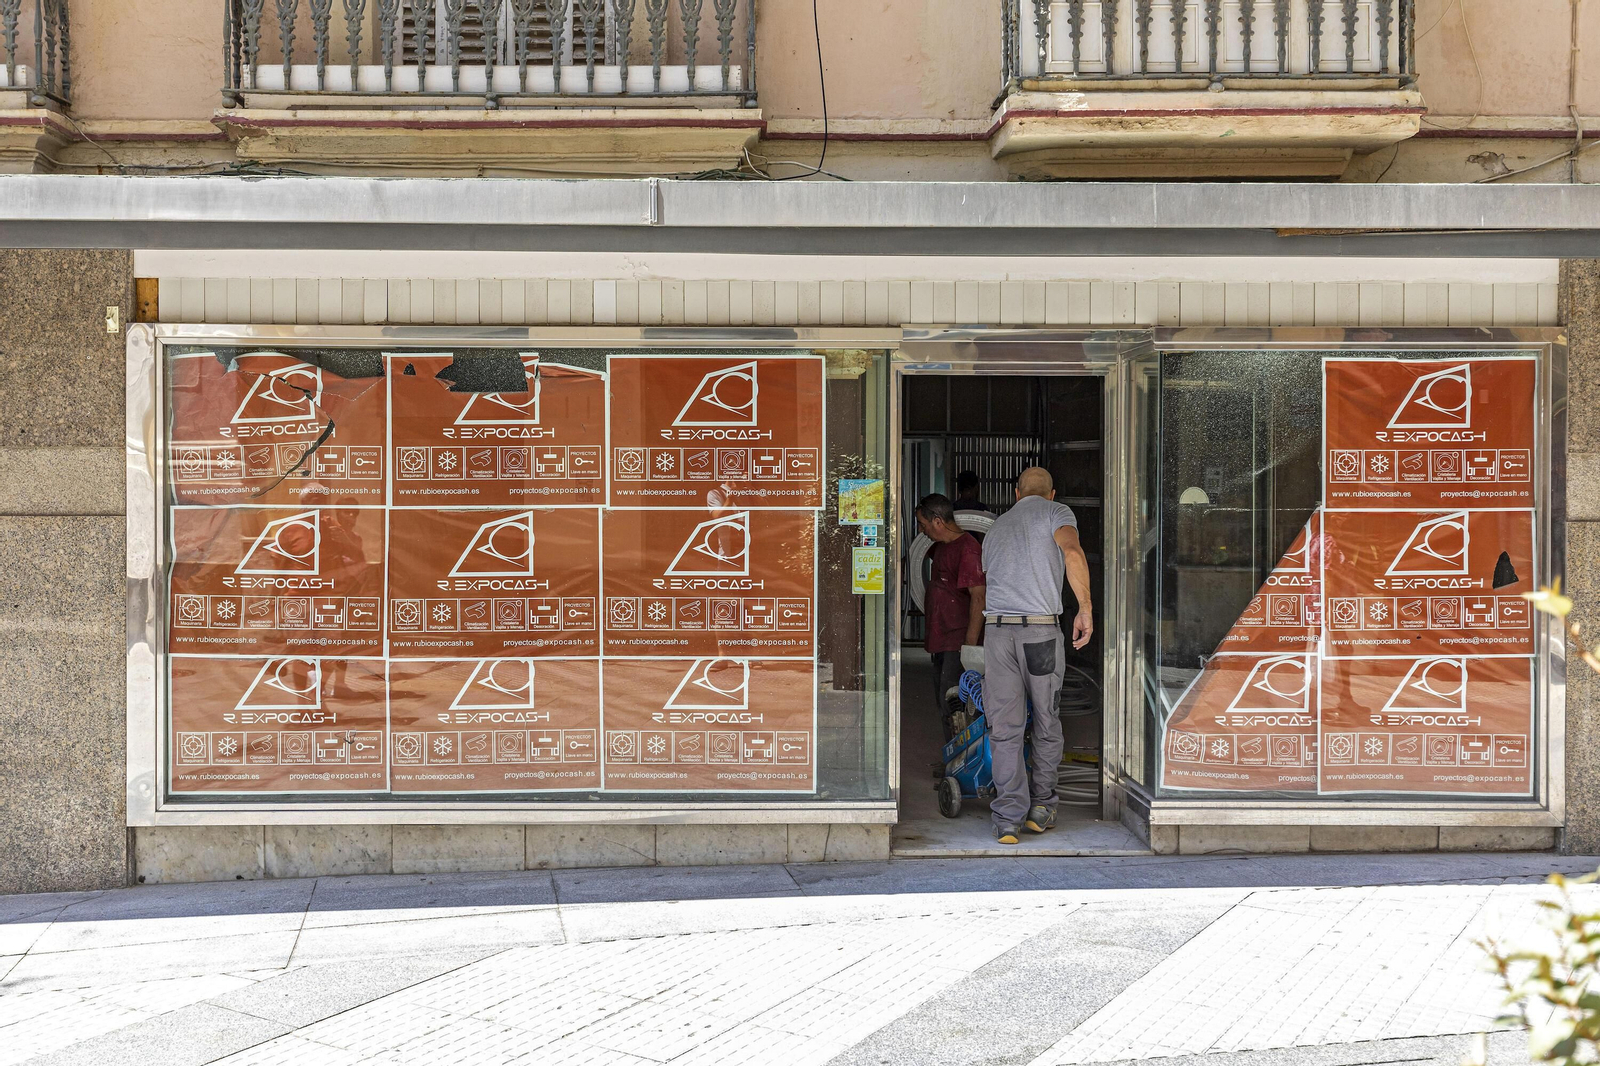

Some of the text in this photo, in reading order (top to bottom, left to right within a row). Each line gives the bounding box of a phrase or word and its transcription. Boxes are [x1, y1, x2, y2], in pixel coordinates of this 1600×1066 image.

[219, 427, 234, 438] R.
[443, 428, 554, 438] R. EXPOCASH
[661, 430, 772, 440] R. EXPOCASH
[1376, 432, 1485, 442] R. EXPOCASH
[181, 486, 260, 495] www.rubioexpocash.es
[289, 487, 381, 496] proyectos@expocash.es
[222, 577, 334, 589] R. EXPOCASH
[438, 579, 548, 590] R. EXPOCASH
[653, 579, 764, 589] R. EXPOCASH
[1374, 578, 1483, 589] R. EXPOCASH
[287, 638, 378, 646] proyectos@expocash.es
[504, 638, 594, 647] proyectos@expocash.es
[1440, 636, 1529, 645] proyectos@expocash.es
[224, 713, 336, 723] R. EXPOCASH
[438, 712, 549, 724] R. EXPOCASH
[652, 713, 763, 723] R. EXPOCASH
[1215, 716, 1229, 726] R.
[1370, 715, 1480, 726] R. EXPOCASH
[290, 772, 381, 780] proyectos@expocash.es
[395, 773, 474, 781] www.rubioexpocash.es
[505, 770, 595, 779] proyectos@expocash.es
[1171, 769, 1249, 780] www.rubioexpocash.es
[1435, 774, 1524, 783] proyectos@expocash.es
